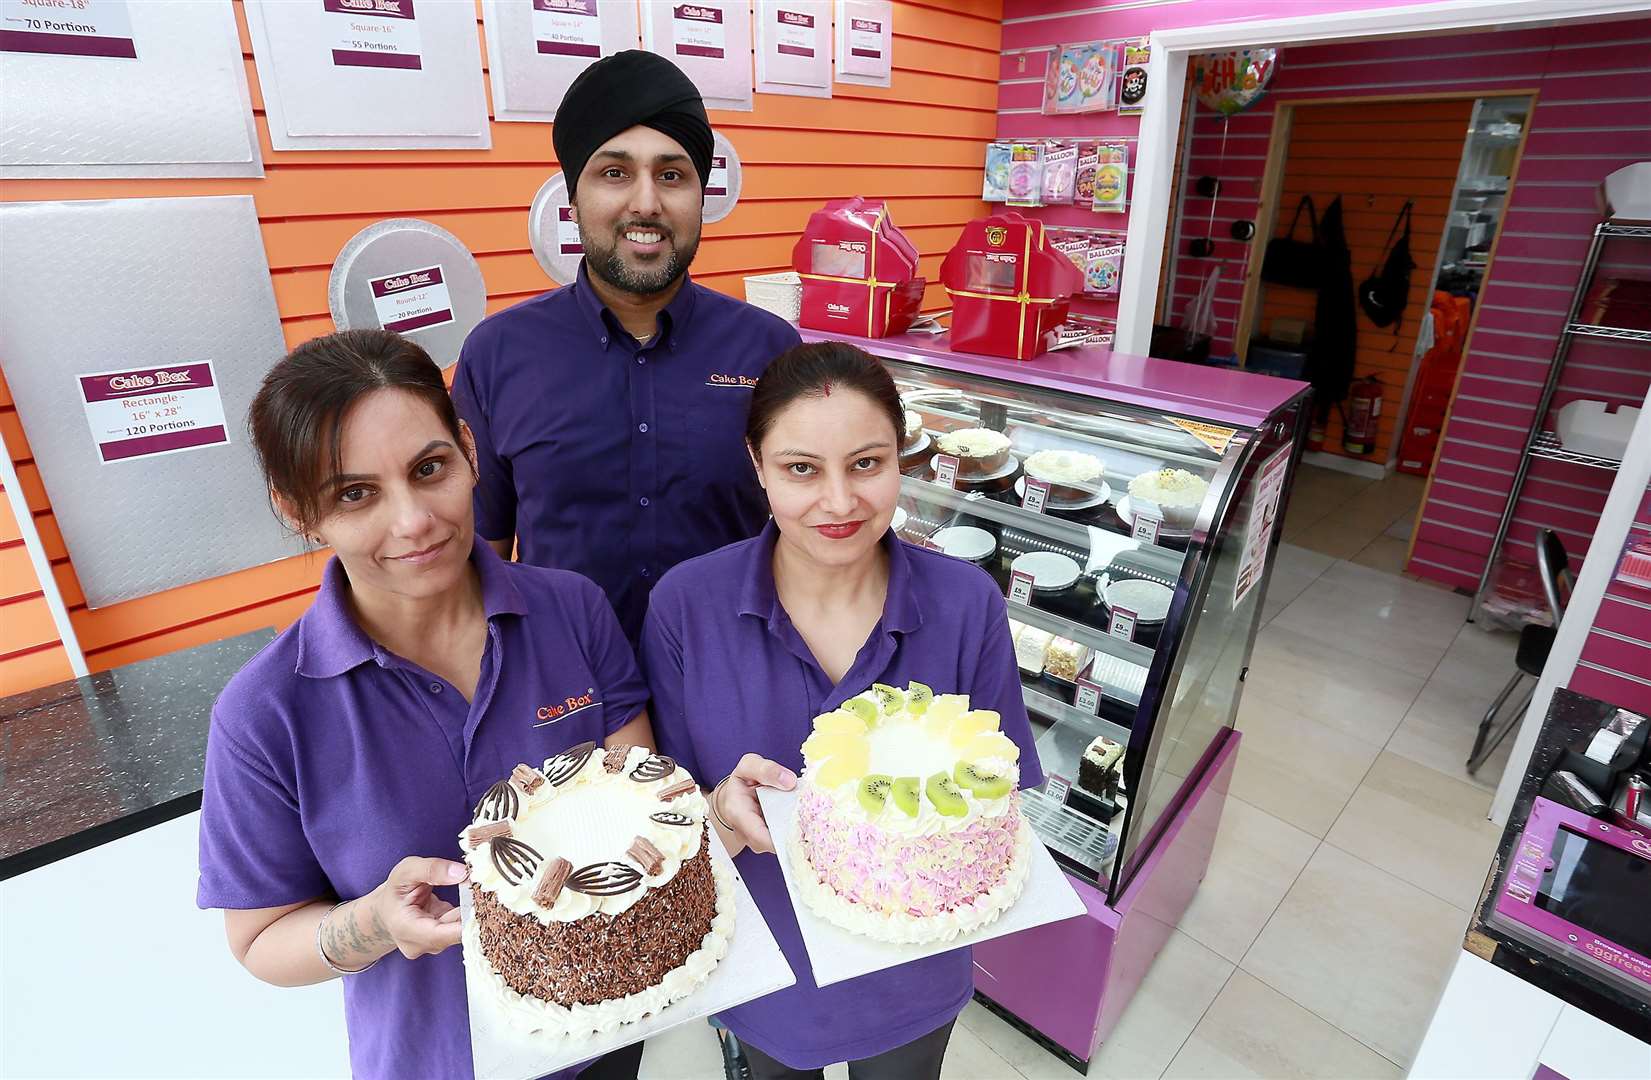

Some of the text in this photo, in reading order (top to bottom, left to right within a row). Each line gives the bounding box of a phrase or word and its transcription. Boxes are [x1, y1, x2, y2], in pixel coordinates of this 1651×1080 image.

[24, 18, 41, 29] 70
[44, 20, 97, 33] Portions
[352, 40, 398, 51] 55 Portions
[1045, 151, 1075, 163] BALLOON
[1089, 247, 1120, 259] BALLOON
[384, 277, 410, 289] Cake
[407, 306, 433, 317] Portions
[109, 369, 191, 390] Cake Box
[710, 374, 738, 384] Cake
[122, 394, 178, 409] Rectangle
[132, 411, 150, 421] 16"
[164, 406, 182, 417] 28"
[126, 426, 147, 436] 120
[149, 419, 196, 432] Portions
[537, 694, 593, 720] Cake Box
